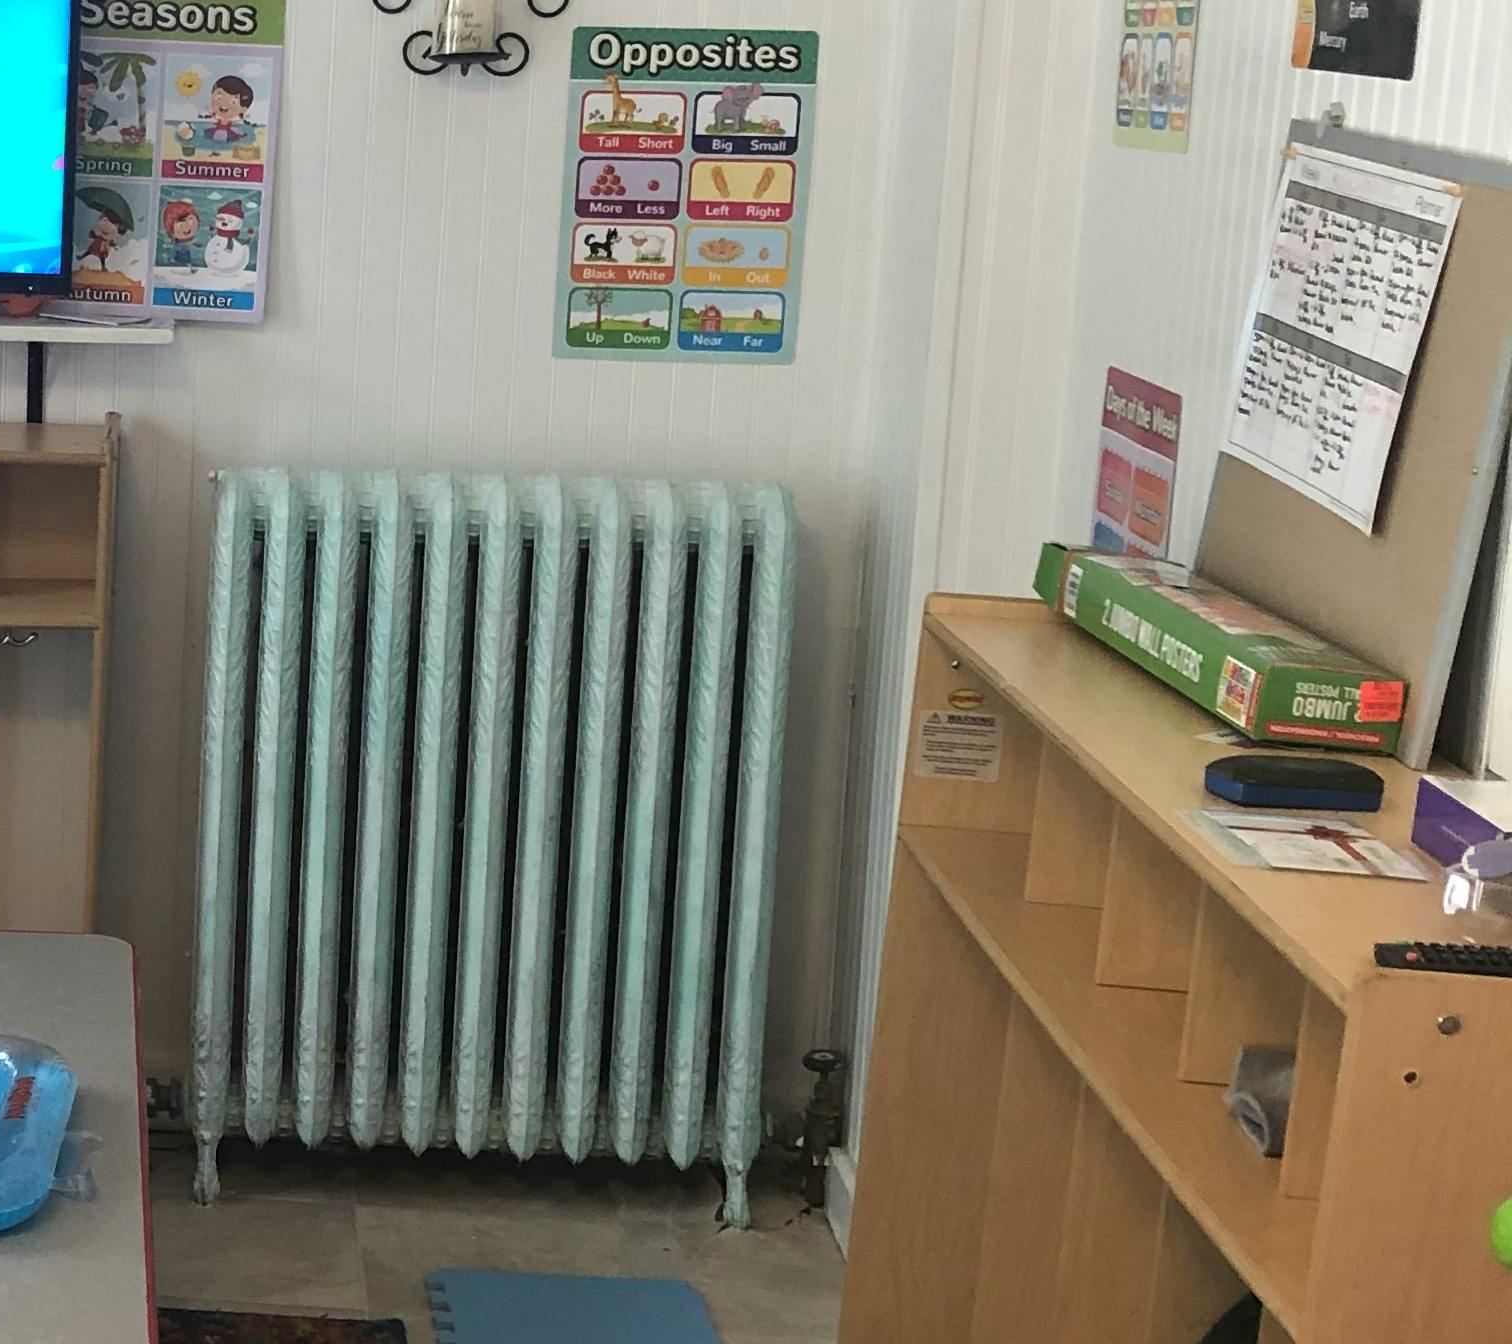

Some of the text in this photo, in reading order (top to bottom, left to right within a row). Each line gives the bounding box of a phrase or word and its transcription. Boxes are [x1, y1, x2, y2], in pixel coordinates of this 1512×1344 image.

[589, 32, 800, 75] Opposites
[597, 136, 674, 150] Tall Short
[711, 139, 786, 152] Big Small
[75, 157, 133, 177] Spring
[175, 161, 250, 179] Summer
[589, 203, 665, 215] More Less
[705, 205, 780, 219] Left Right
[582, 268, 666, 282] Black White
[708, 271, 771, 284] In Out
[70, 286, 131, 302] utumn
[173, 290, 234, 308] Winter
[585, 332, 661, 345] Up Down
[692, 334, 764, 347] Near Far
[1295, 682, 1340, 699] POSTERS
[1292, 696, 1352, 721] JUMBO
